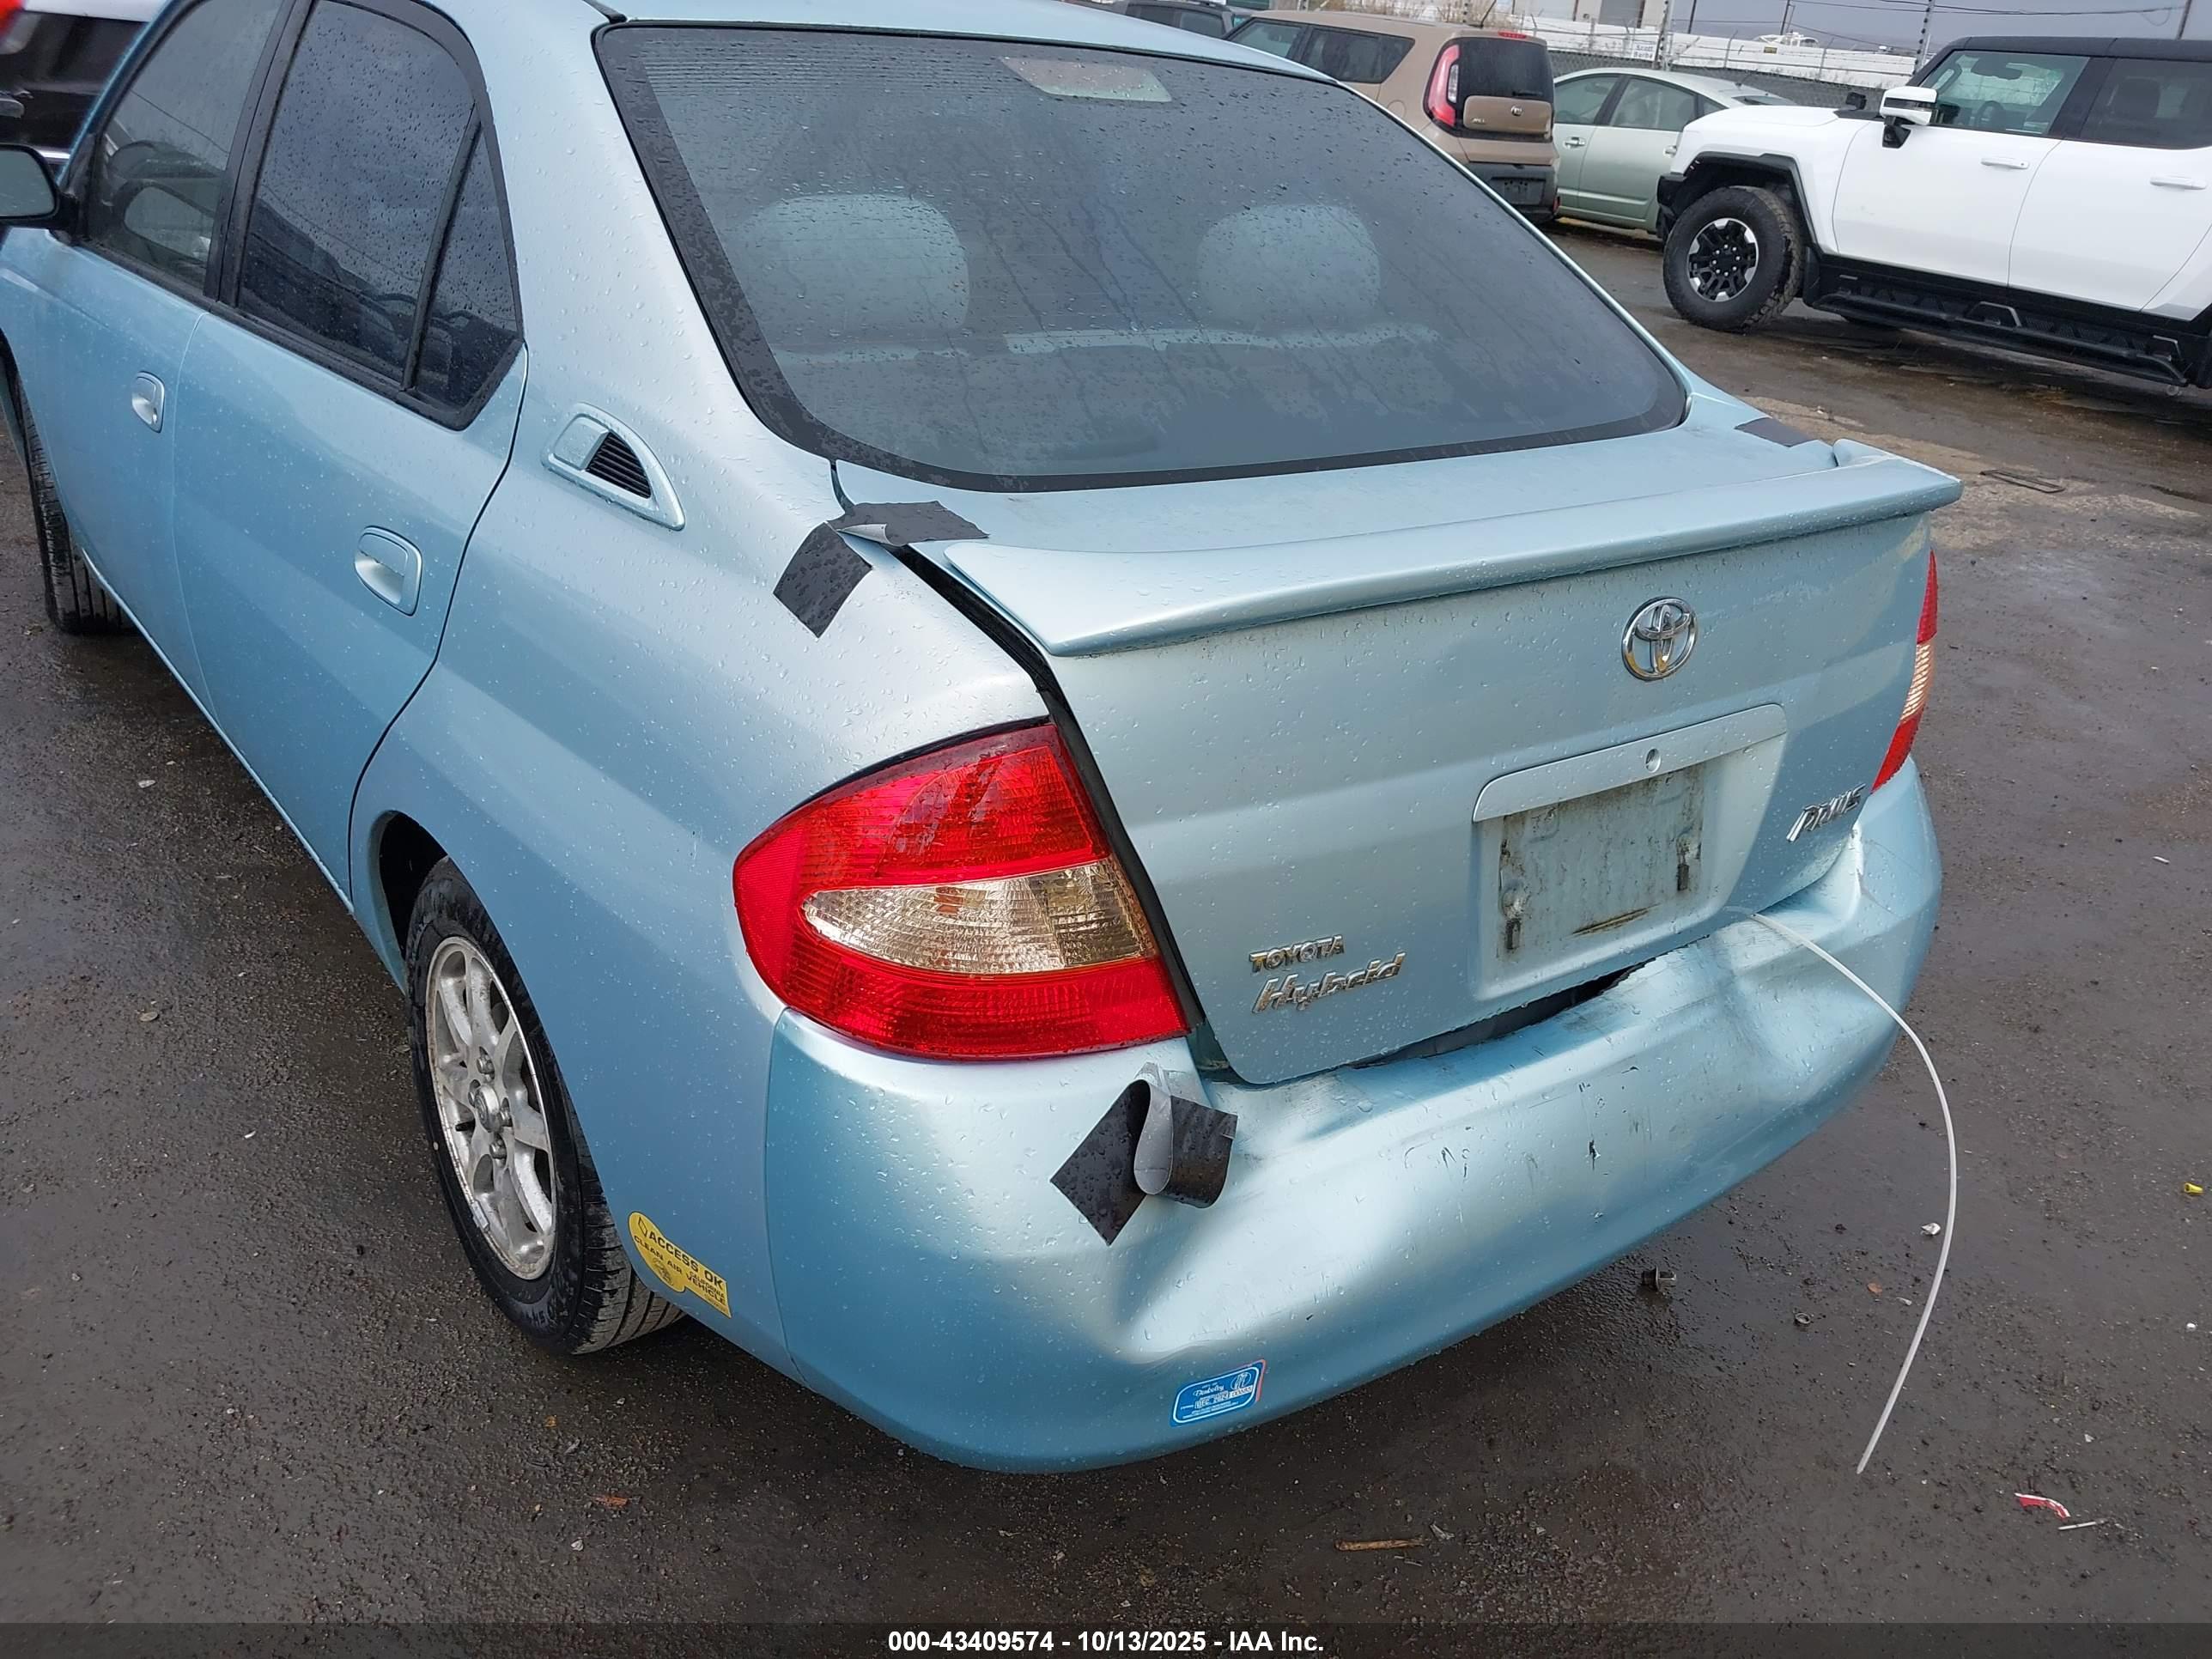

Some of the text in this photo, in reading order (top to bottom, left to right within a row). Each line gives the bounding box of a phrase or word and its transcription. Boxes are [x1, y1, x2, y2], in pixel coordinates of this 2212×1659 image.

[1249, 933, 1345, 974] TOYOTA
[1251, 951, 1407, 1014] Hybrid
[634, 1235, 664, 1261] CLEAN
[667, 1259, 683, 1274] AIR
[686, 1273, 726, 1305] VEHICLE
[648, 1231, 723, 1290] ACCESS OK
